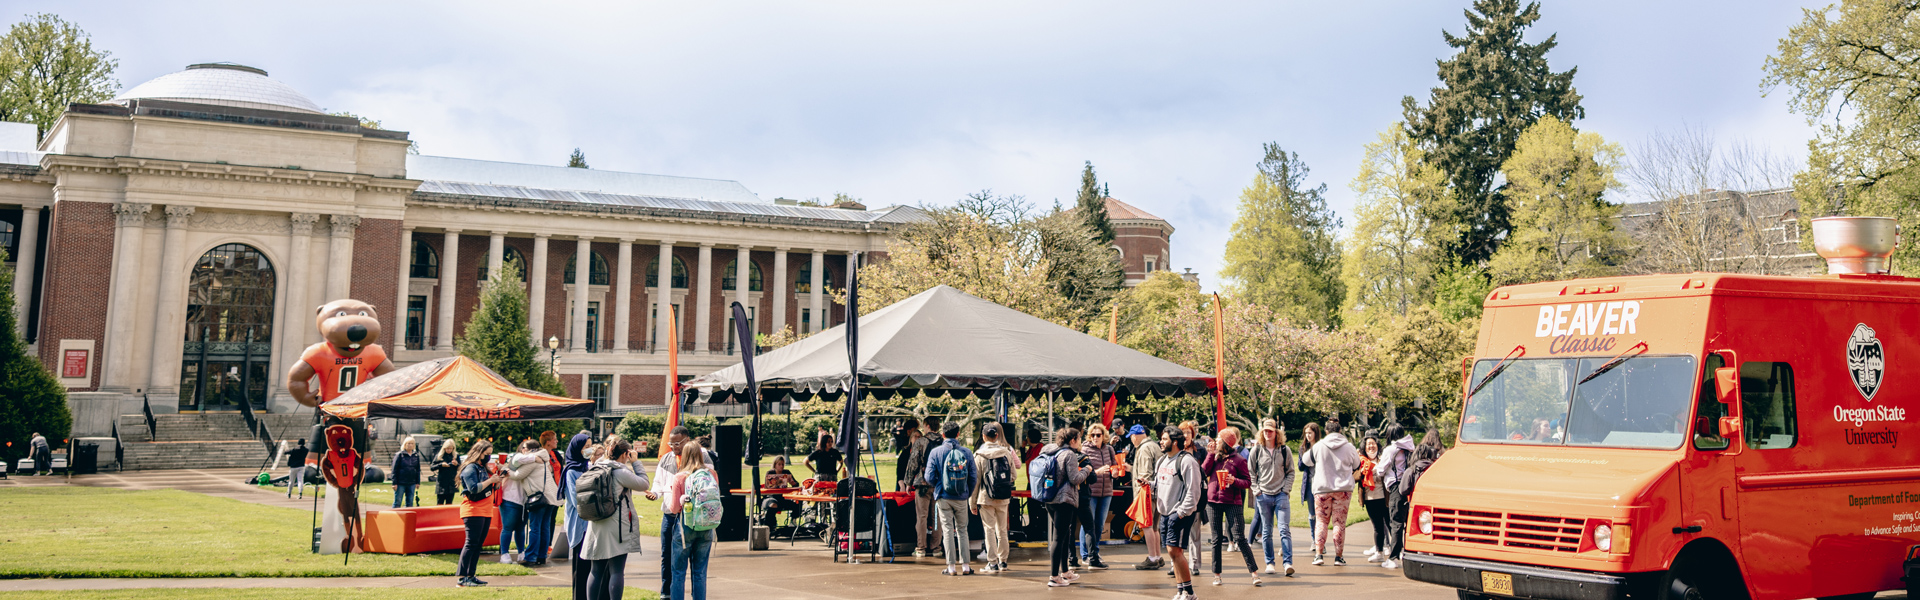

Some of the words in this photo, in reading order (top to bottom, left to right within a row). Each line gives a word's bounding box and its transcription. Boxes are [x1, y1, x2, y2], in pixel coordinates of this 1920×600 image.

[1535, 300, 1640, 337] BEAVER
[1549, 332, 1617, 355] Classic
[335, 357, 363, 365] BEAVS
[444, 405, 521, 419] BEAVERS
[1833, 404, 1877, 427] Oregon
[1876, 404, 1906, 422] State
[1844, 426, 1899, 449] University
[1848, 493, 1895, 509] Department
[1895, 491, 1904, 504] of
[1904, 491, 1920, 503] Foo
[1864, 528, 1870, 536] to
[1871, 526, 1892, 536] Advance
[1892, 523, 1903, 536] Safe
[1902, 523, 1913, 533] and
